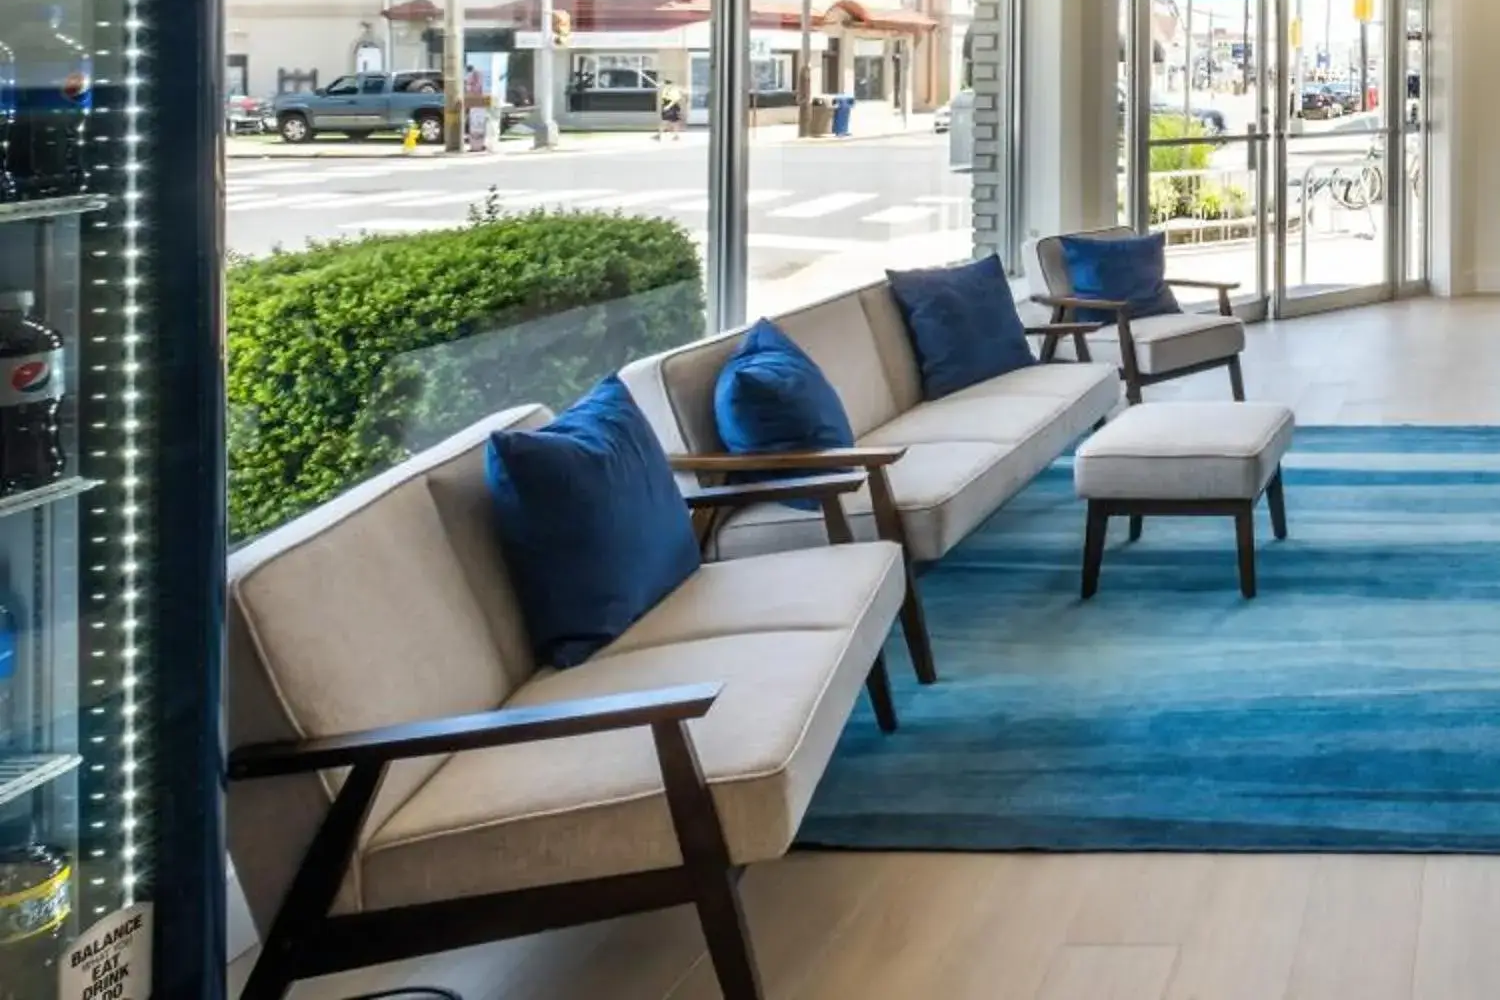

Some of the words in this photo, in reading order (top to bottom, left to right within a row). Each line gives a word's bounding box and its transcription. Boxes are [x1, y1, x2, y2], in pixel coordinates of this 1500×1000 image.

[71, 914, 143, 968] BALANCE
[82, 962, 129, 1000] DRINK
[92, 953, 120, 981] EAT
